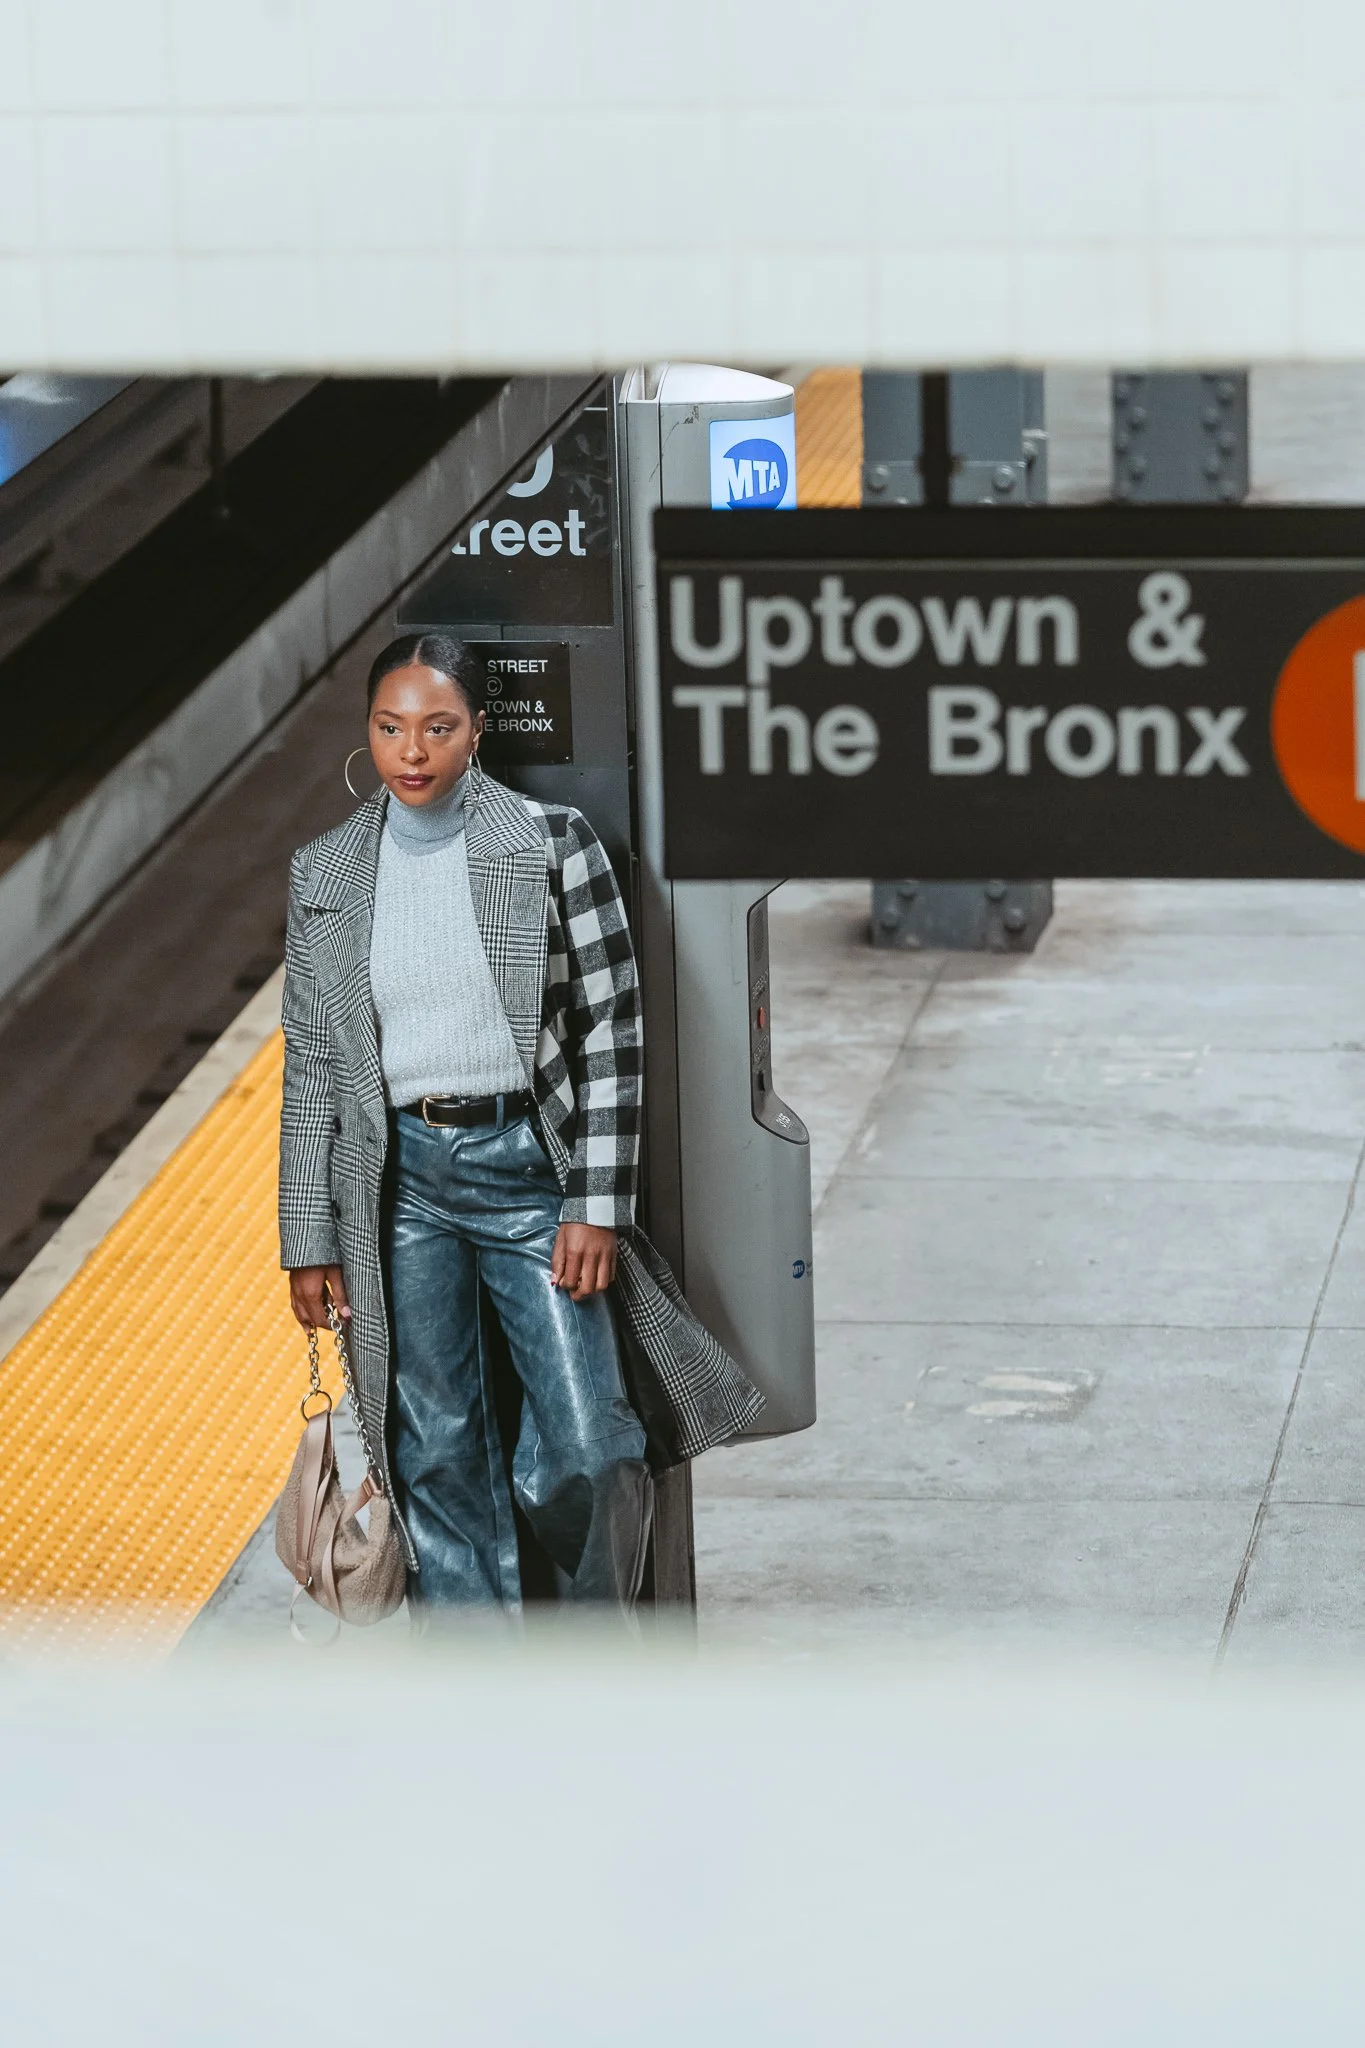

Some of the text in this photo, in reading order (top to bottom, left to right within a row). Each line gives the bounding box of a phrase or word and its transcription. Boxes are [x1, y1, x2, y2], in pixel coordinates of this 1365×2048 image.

[722, 457, 781, 502] MTA
[452, 510, 587, 557] reet
[668, 570, 1206, 686] Uptown &
[487, 659, 548, 673] STREET
[498, 718, 554, 731] BRONX
[534, 699, 546, 714] &
[672, 683, 880, 778] The
[927, 683, 1250, 778] Bronx
